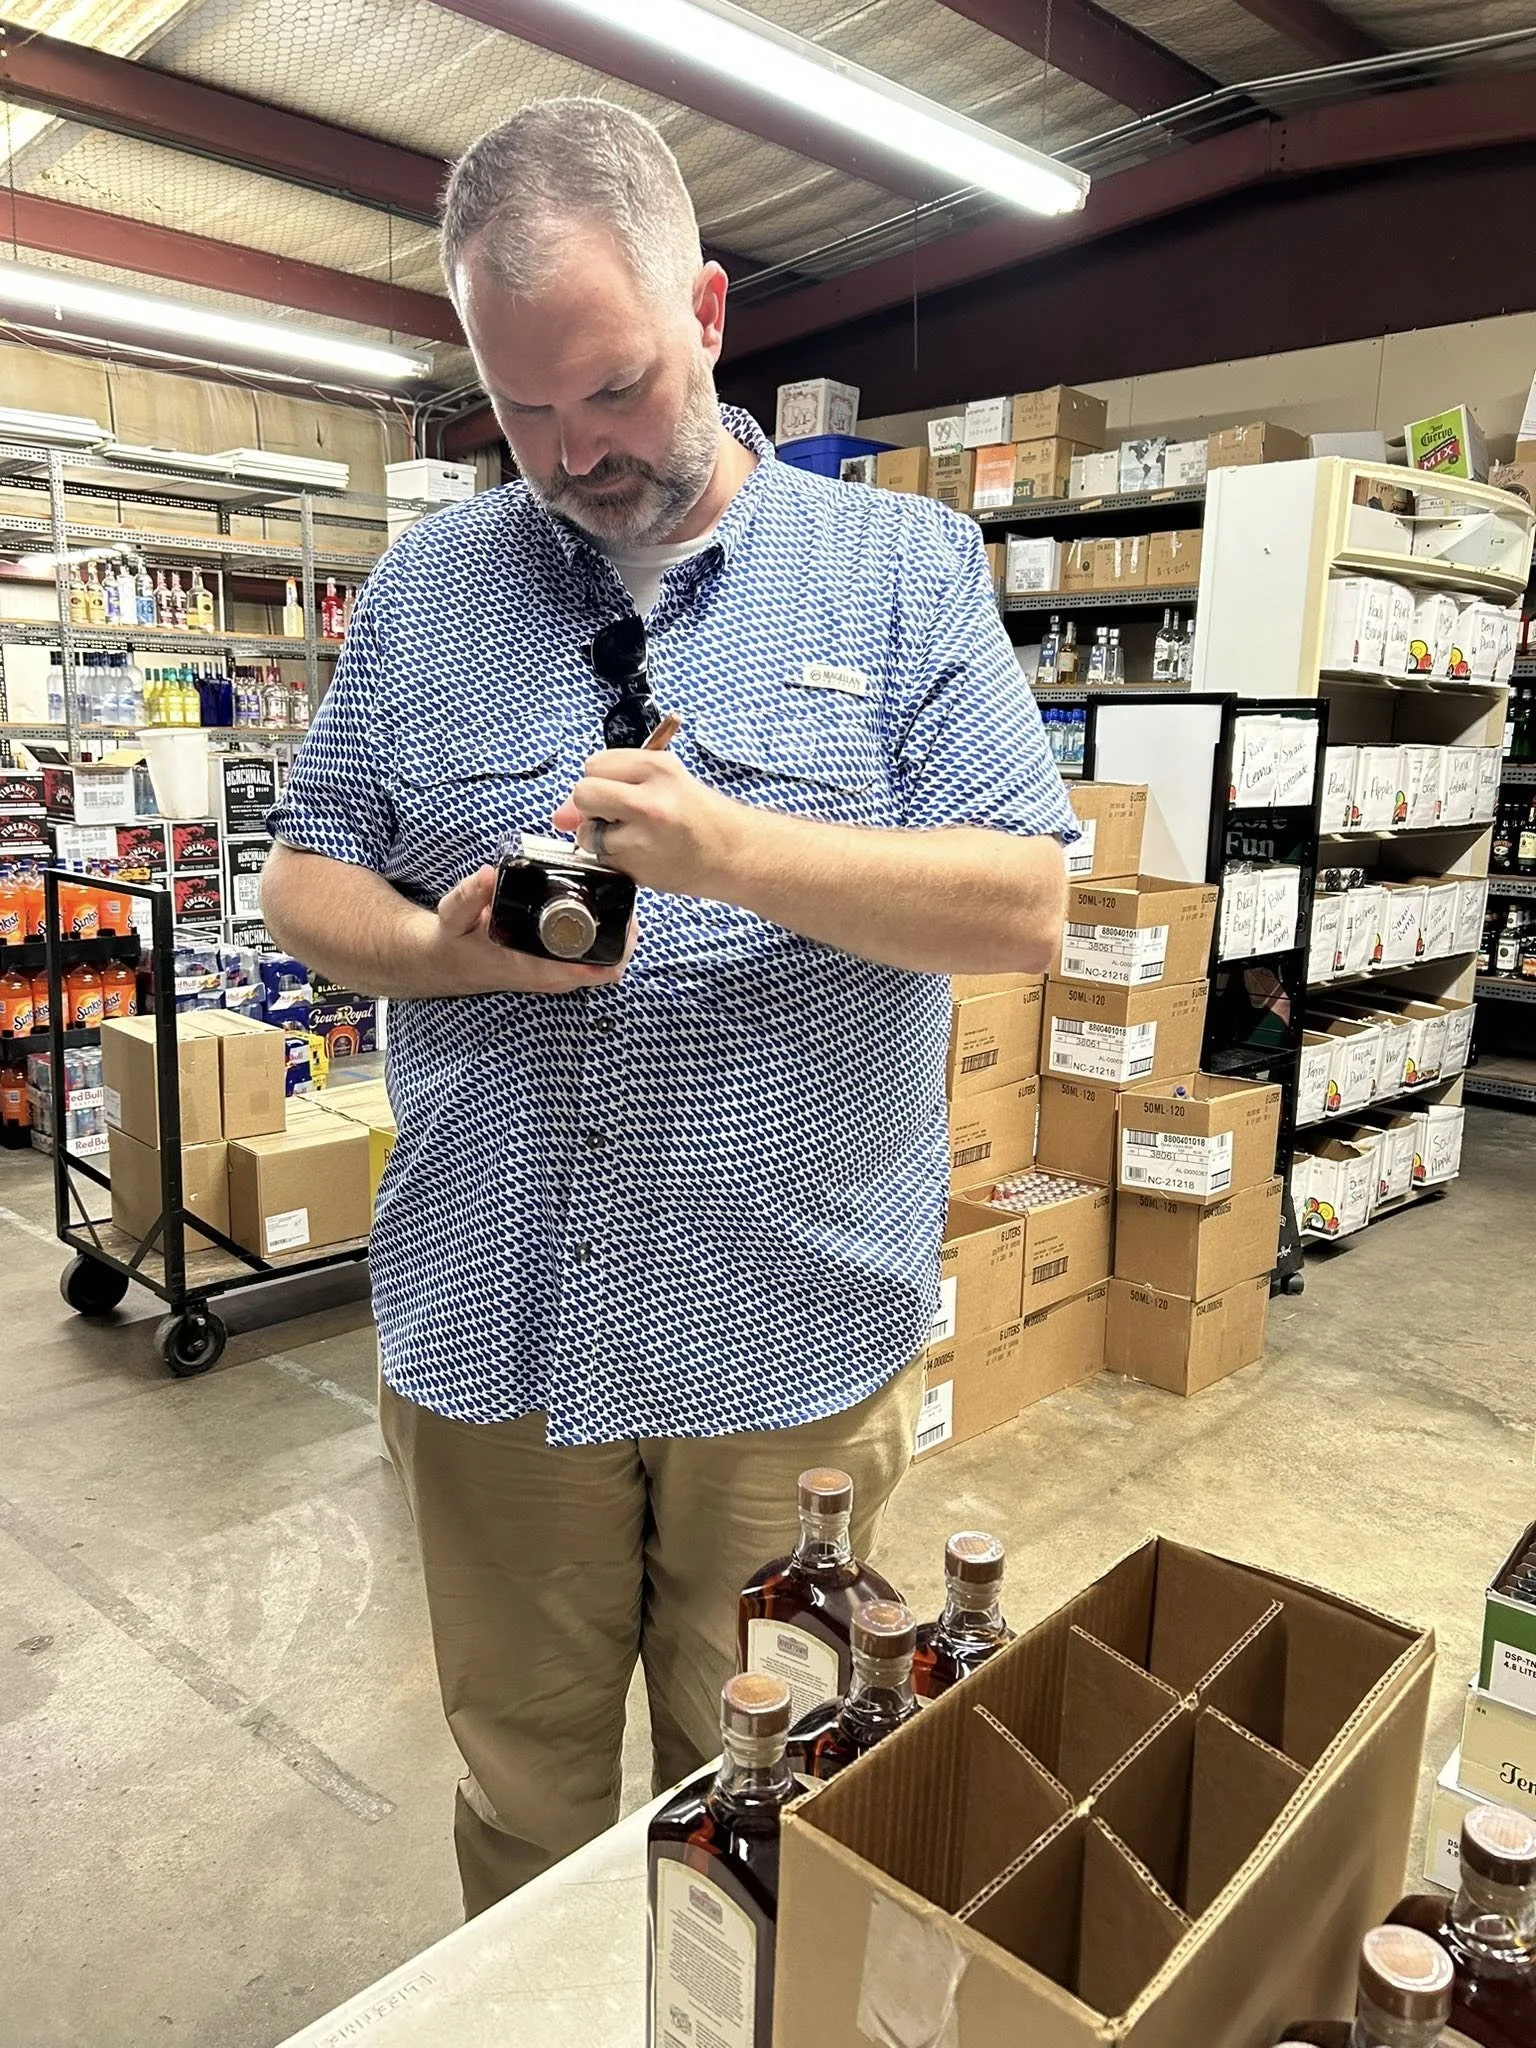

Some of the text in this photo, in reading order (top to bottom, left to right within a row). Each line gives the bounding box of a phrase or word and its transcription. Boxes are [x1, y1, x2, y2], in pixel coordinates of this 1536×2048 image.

[1420, 427, 1453, 447] Cuervo
[1424, 445, 1454, 470] MIX
[822, 670, 861, 687] MAGELLAN
[225, 770, 274, 788] BENCHMARK
[1224, 831, 1275, 858] Fun
[1078, 893, 1116, 909] 50ML-120
[1085, 967, 1130, 981] NC-21218
[317, 984, 345, 993] BLACK
[1027, 990, 1040, 1003] LITERS
[1068, 990, 1106, 1006] 50ML-120
[308, 1003, 374, 1029] Crown Royal
[1088, 1023, 1127, 1037] 8800401018
[1075, 1037, 1101, 1049] 38061
[1073, 1062, 1116, 1077] NC-21218
[85, 1086, 103, 1101] Bull
[1022, 1084, 1036, 1097] LITERS
[1060, 1083, 1096, 1101] 50ML-120
[1143, 1102, 1185, 1117] 50ML-120
[75, 1136, 108, 1150] Red Bu
[1163, 1134, 1206, 1147] 8800401018
[1150, 1149, 1177, 1161] 38061
[1147, 1175, 1195, 1189] NC-21218
[1270, 1184, 1282, 1197] LITERS
[1139, 1196, 1178, 1215] 50ML-120
[1005, 1225, 1022, 1240] LITERS
[1091, 1286, 1106, 1301] LITERS
[1130, 1289, 1168, 1310] 50ML-120
[1004, 1323, 1021, 1339] LITERS
[1503, 1661, 1517, 1672] 4.8
